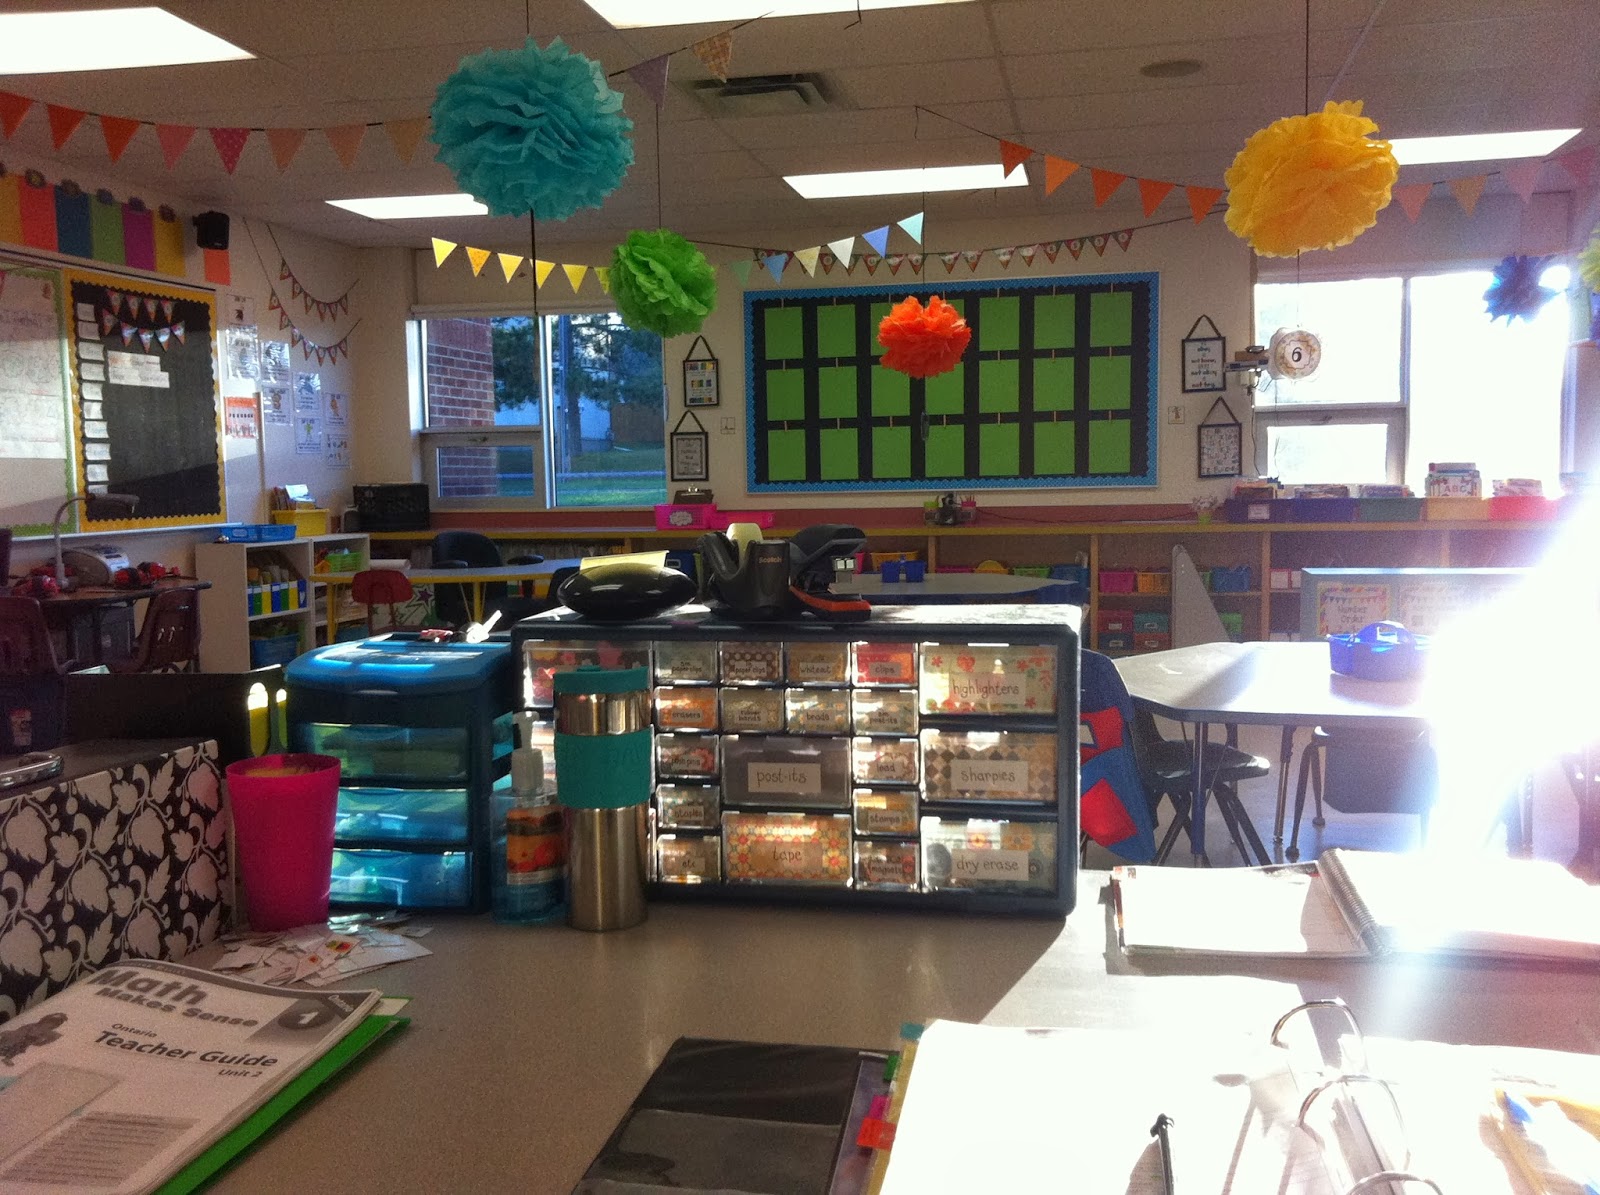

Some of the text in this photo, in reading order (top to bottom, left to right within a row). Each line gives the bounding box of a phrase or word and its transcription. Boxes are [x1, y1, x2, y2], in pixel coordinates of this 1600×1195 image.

[1291, 346, 1303, 363] 6
[759, 556, 782, 564] Scotch
[753, 666, 766, 674] clips
[875, 665, 895, 674] clips
[952, 680, 1019, 698] highlighters
[672, 711, 701, 719] erasers
[756, 767, 808, 787] post-its
[960, 767, 1016, 786] sharpies
[674, 807, 703, 818] staples
[869, 812, 900, 824] stamps
[773, 846, 803, 862] tape
[956, 855, 1019, 875] dry erase
[87, 970, 208, 1005] Math
[95, 987, 259, 1027] Makes Sense
[297, 1011, 319, 1025] 1
[111, 1023, 158, 1038] Ontario
[95, 1030, 279, 1067] Teacher Guide
[218, 1069, 249, 1077] Unit
